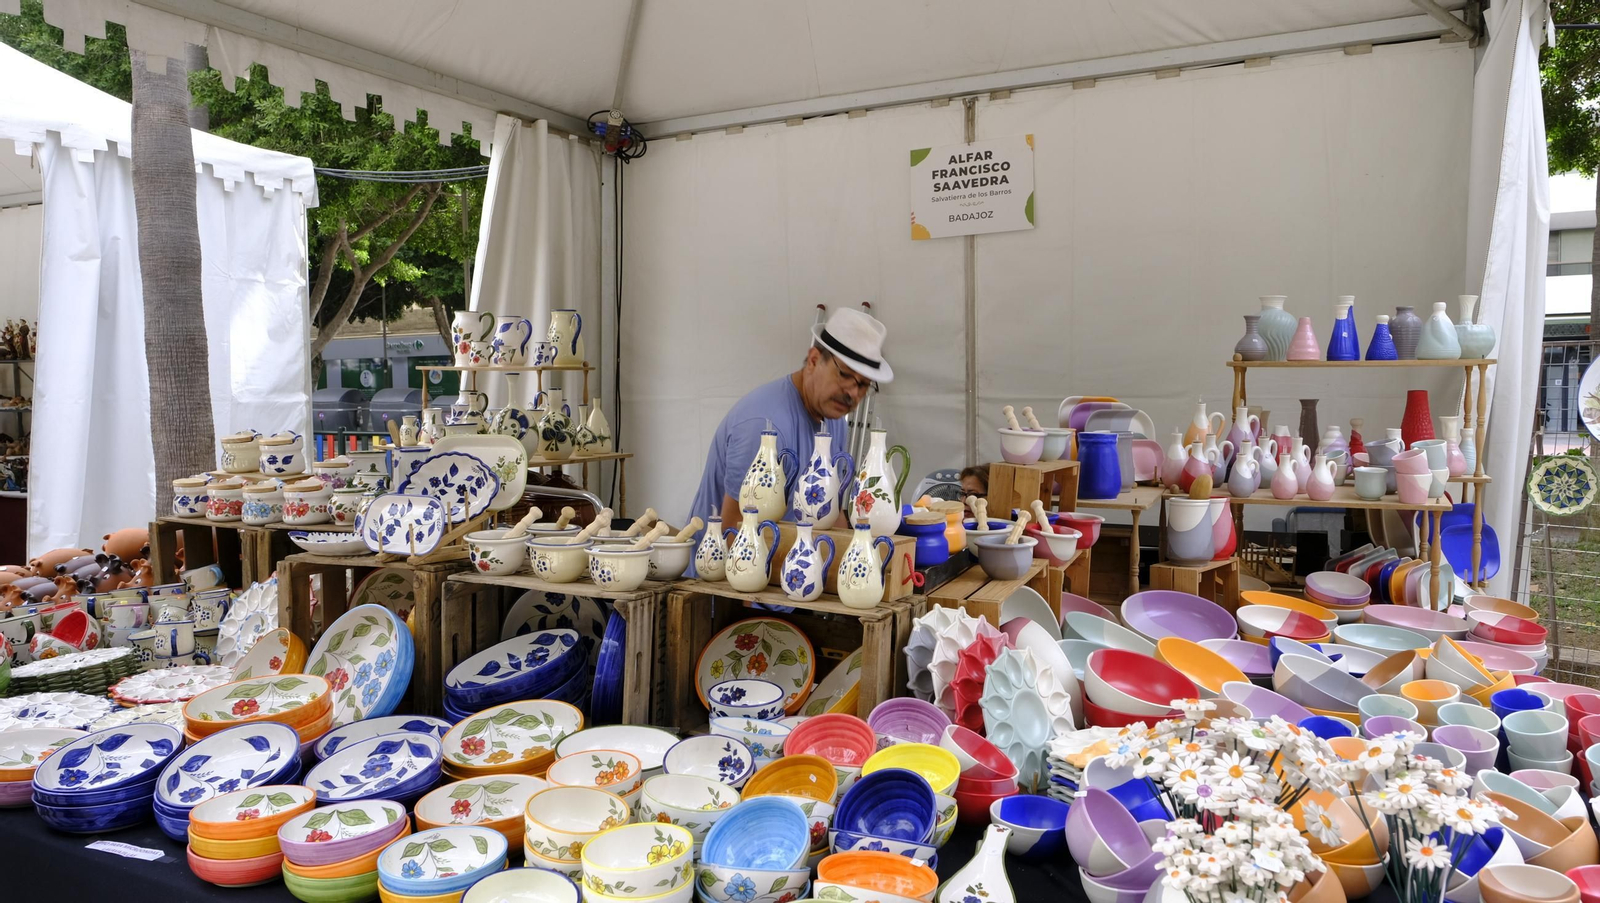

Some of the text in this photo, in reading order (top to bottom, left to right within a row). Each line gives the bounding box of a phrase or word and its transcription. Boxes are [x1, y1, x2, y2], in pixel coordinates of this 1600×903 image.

[948, 150, 993, 165] ALFAR
[931, 161, 1011, 180] FRANCISCO
[933, 174, 1009, 193] SAAVEDRA
[931, 193, 967, 203] Salvatierra
[989, 188, 1012, 197] Barros
[948, 210, 994, 223] BADAJOZ
